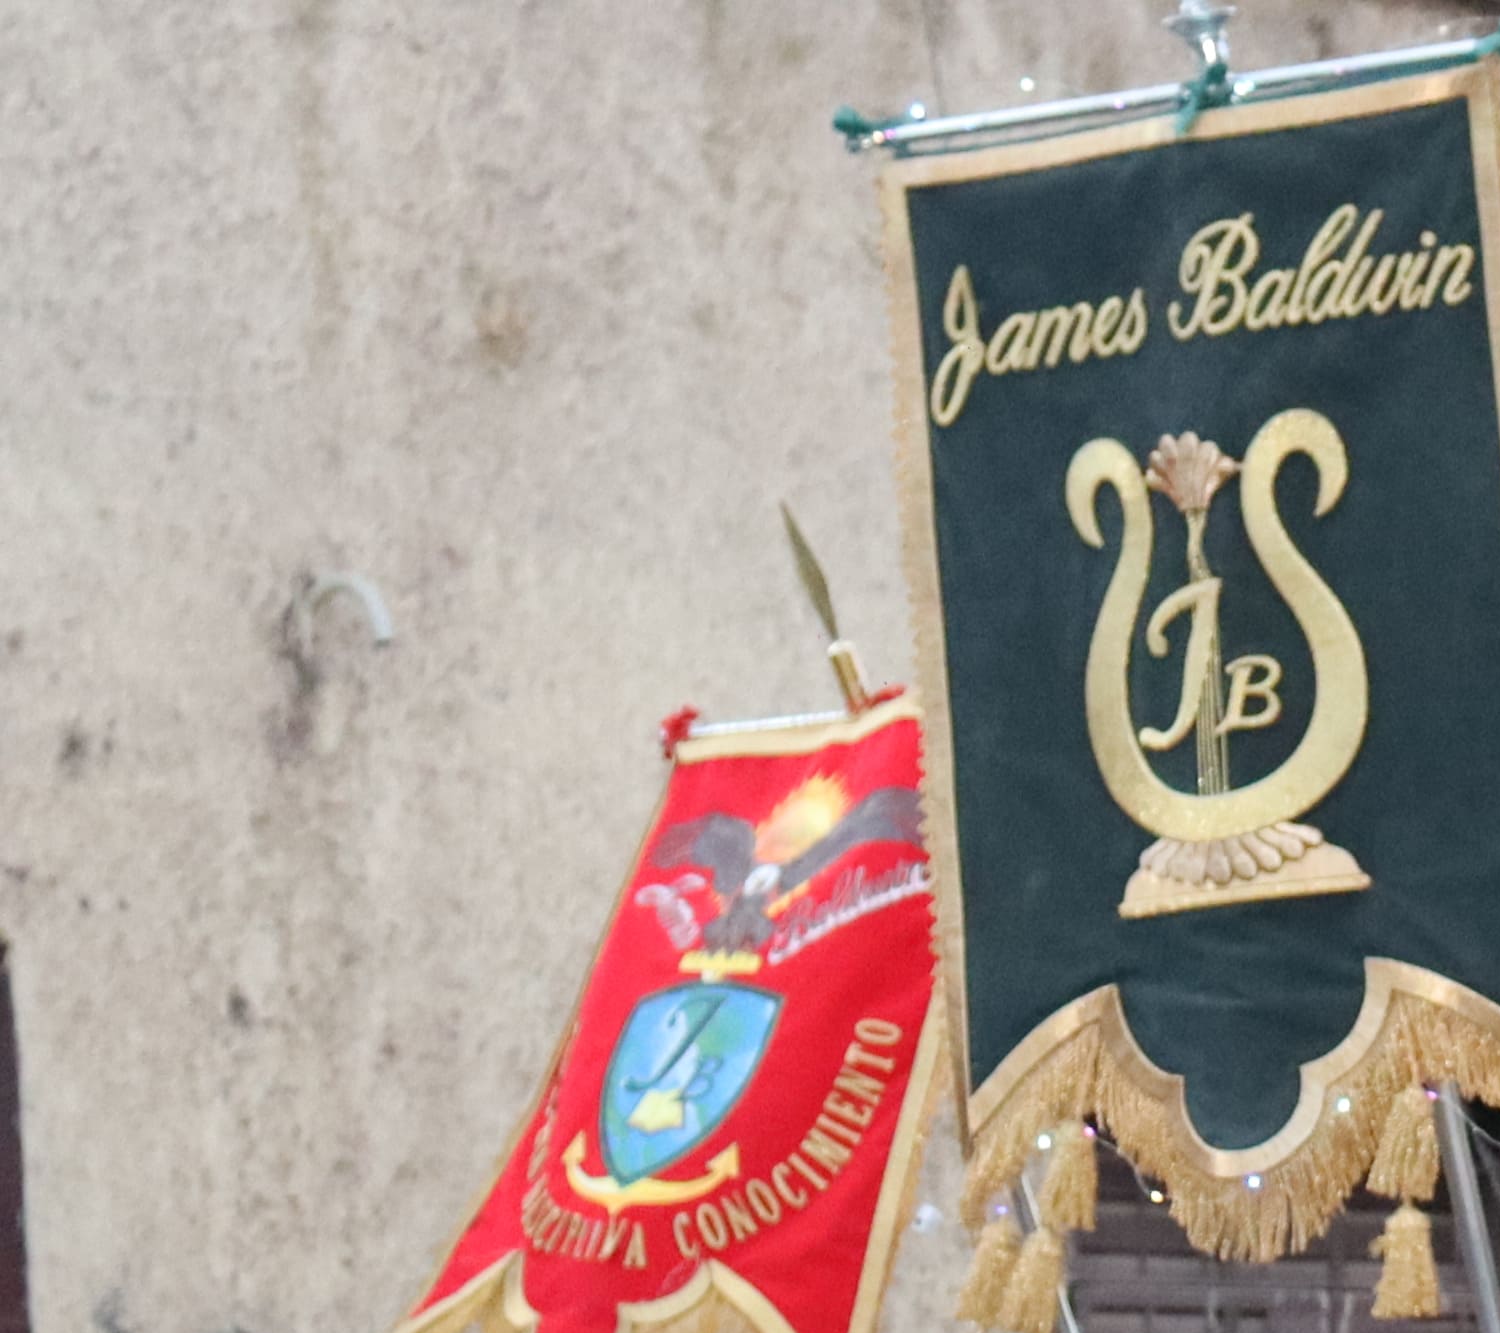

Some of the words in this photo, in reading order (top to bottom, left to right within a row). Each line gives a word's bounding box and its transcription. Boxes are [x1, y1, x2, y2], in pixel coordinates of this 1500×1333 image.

[931, 265, 1148, 427] James
[1169, 204, 1475, 340] Baldwin
[673, 1017, 901, 1258] CONOCIMIENTO
